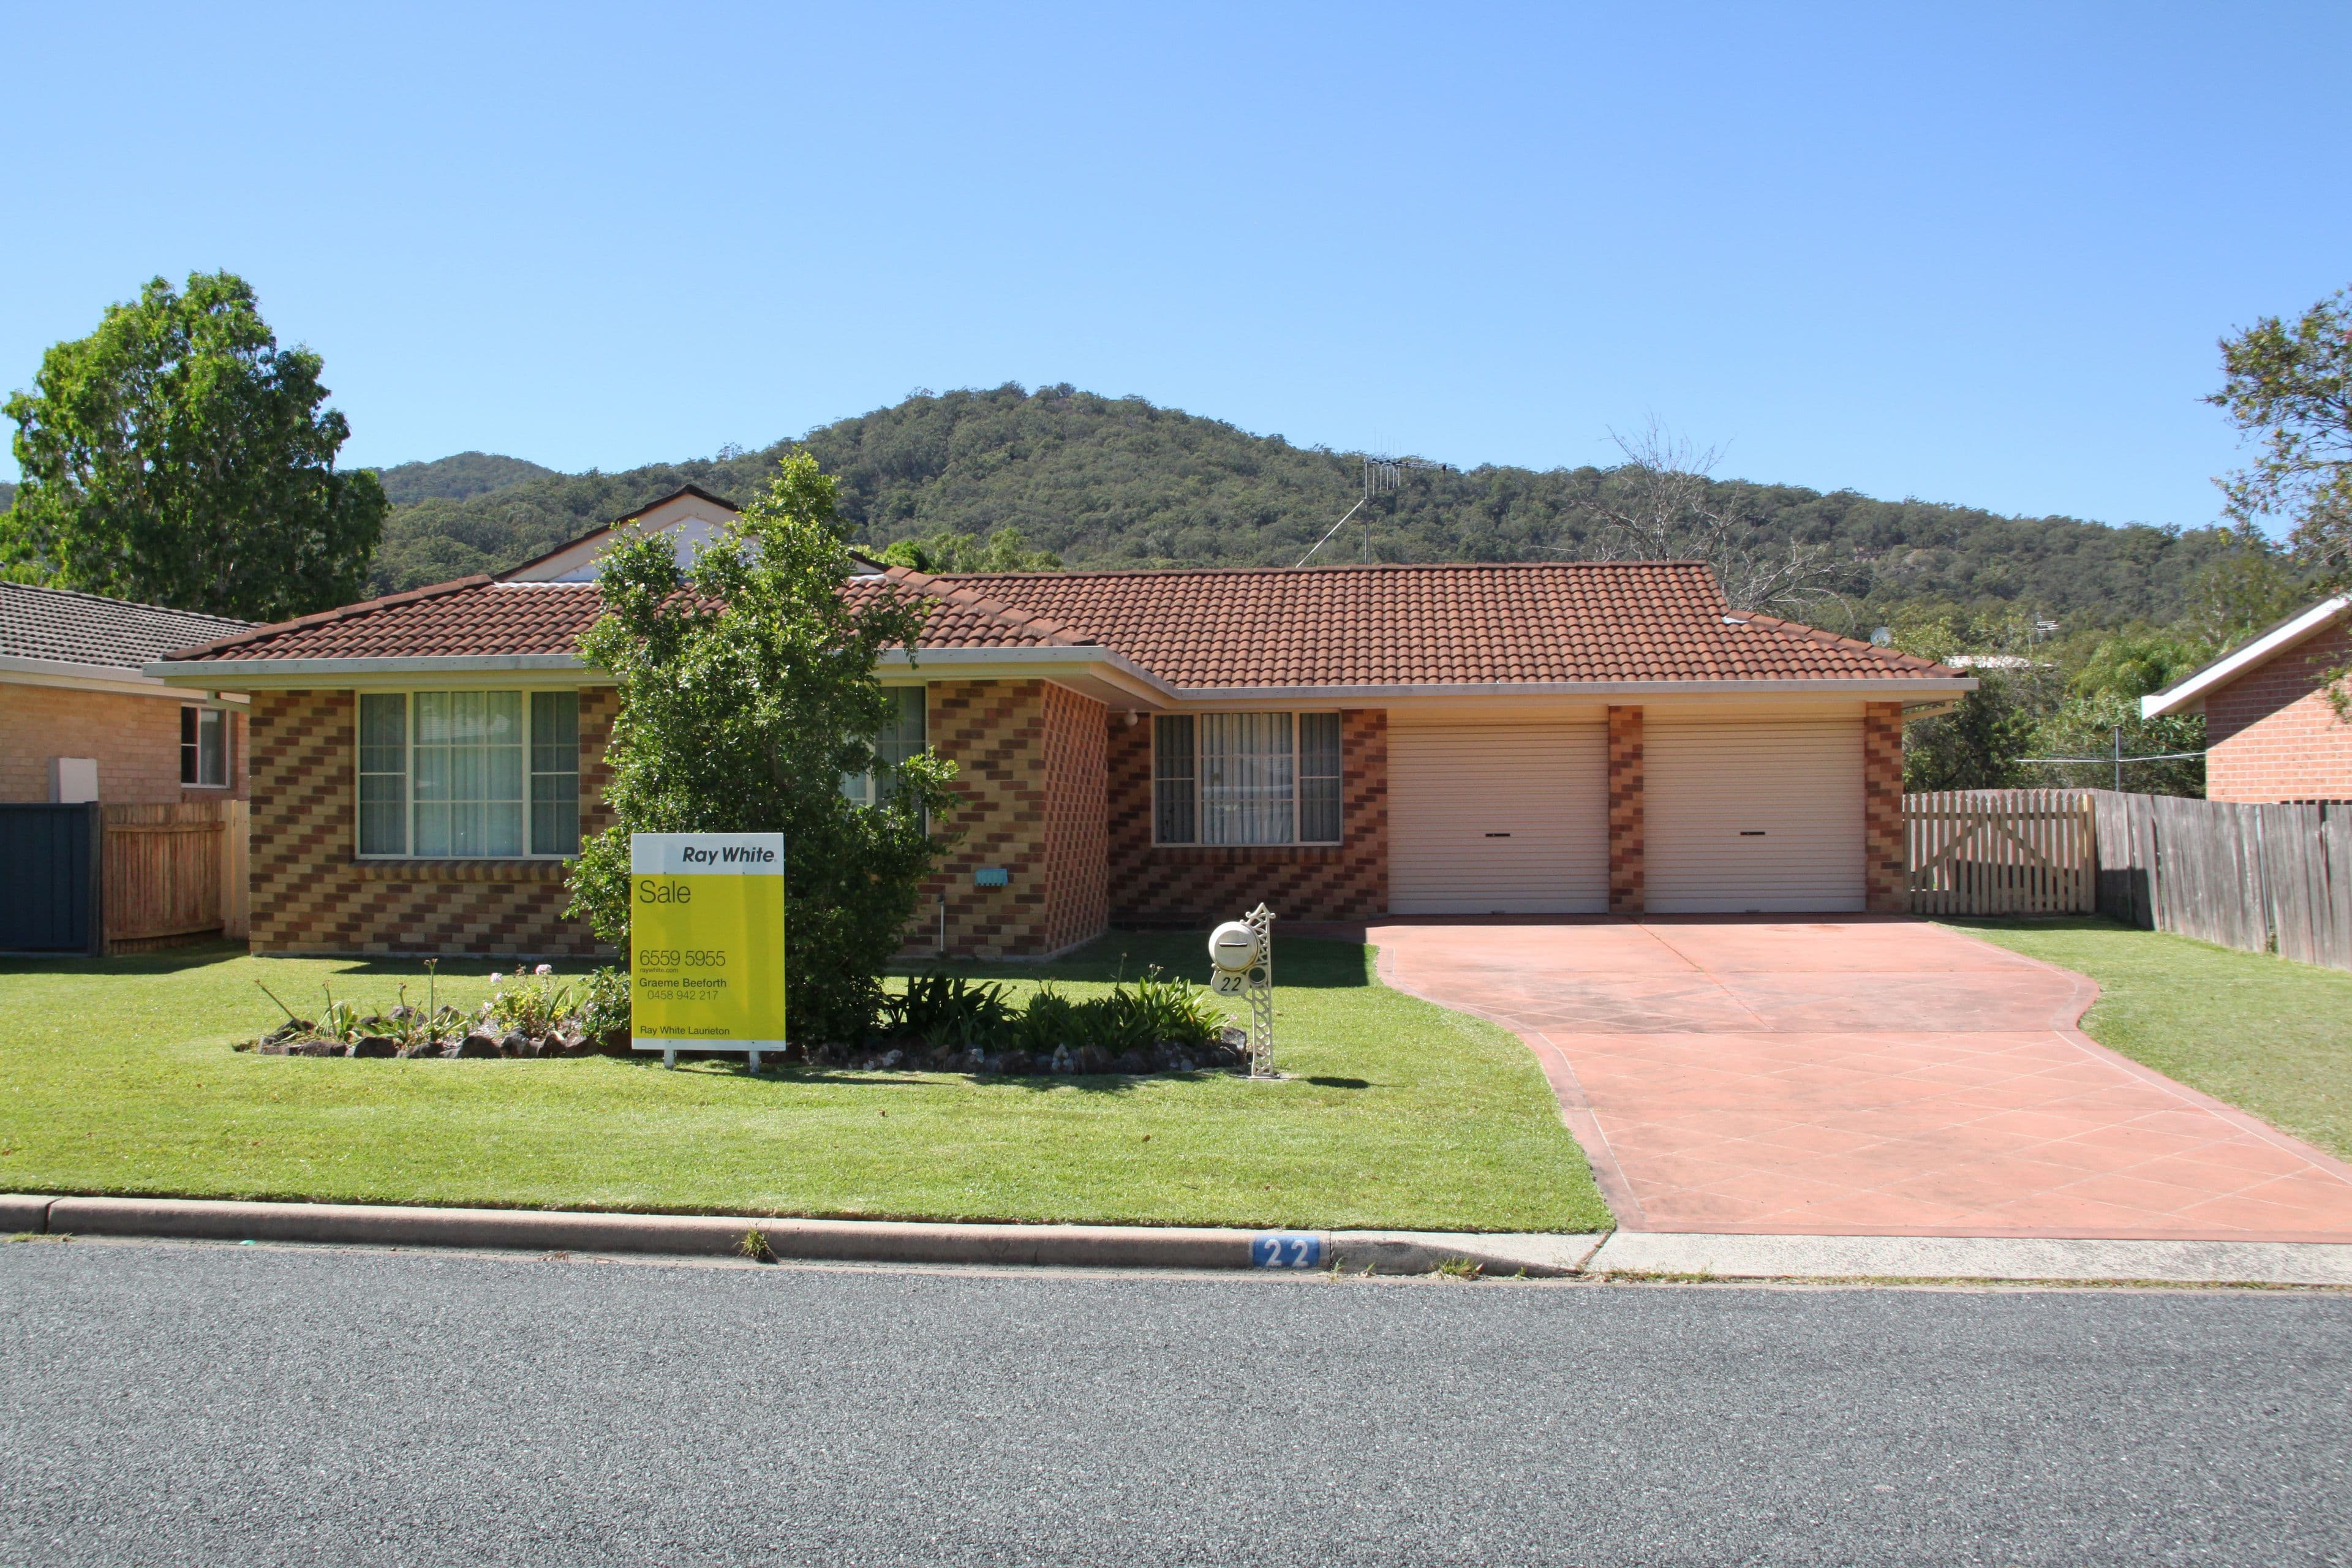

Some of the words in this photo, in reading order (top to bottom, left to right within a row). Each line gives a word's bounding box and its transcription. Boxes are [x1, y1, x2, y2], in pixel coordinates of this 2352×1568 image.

[682, 846, 718, 865] Ray
[722, 846, 775, 862] White
[639, 880, 691, 903] Sale
[639, 949, 680, 966] 6559
[685, 950, 726, 967] 5955
[639, 978, 679, 987] Graeme
[683, 978, 726, 987] Beeforth
[1220, 976, 1242, 992] 22
[647, 990, 674, 1000] 0458
[677, 990, 696, 1000] 942
[699, 990, 718, 1000] 217
[640, 1025, 657, 1036] Ray
[660, 1026, 685, 1035] White
[688, 1026, 730, 1036] Laurieton
[1264, 1238, 1309, 1267] 22
